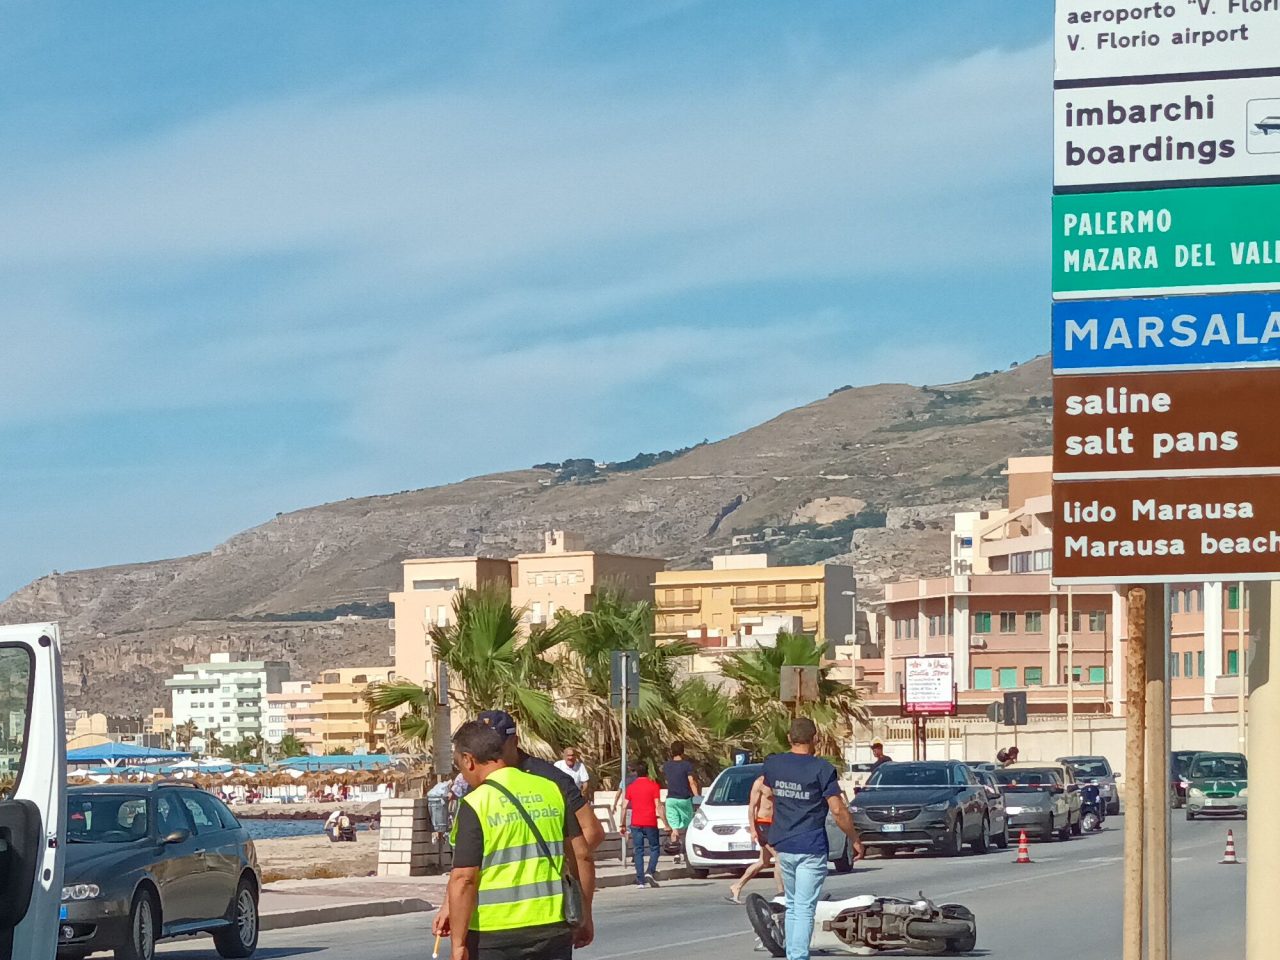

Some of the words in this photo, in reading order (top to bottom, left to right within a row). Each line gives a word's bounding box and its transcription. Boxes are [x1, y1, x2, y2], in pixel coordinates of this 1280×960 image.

[1067, 1, 1176, 25] aeroporto
[1067, 34, 1085, 52] V.
[1097, 30, 1160, 50] Florio
[1171, 23, 1249, 47] airport
[1065, 93, 1214, 127] imbarchi
[1065, 135, 1236, 167] boardings
[1063, 208, 1172, 237] PALERMO
[1063, 245, 1159, 273] MAZARA
[1175, 243, 1216, 268] DEL
[1064, 311, 1280, 351] MARSALA
[1065, 386, 1172, 416] saline
[1064, 426, 1134, 456] salt
[1152, 430, 1239, 459] pans
[1063, 500, 1117, 524] lido
[1132, 498, 1254, 522] Marausa
[1064, 535, 1186, 558] Marausa
[1200, 530, 1280, 555] beach
